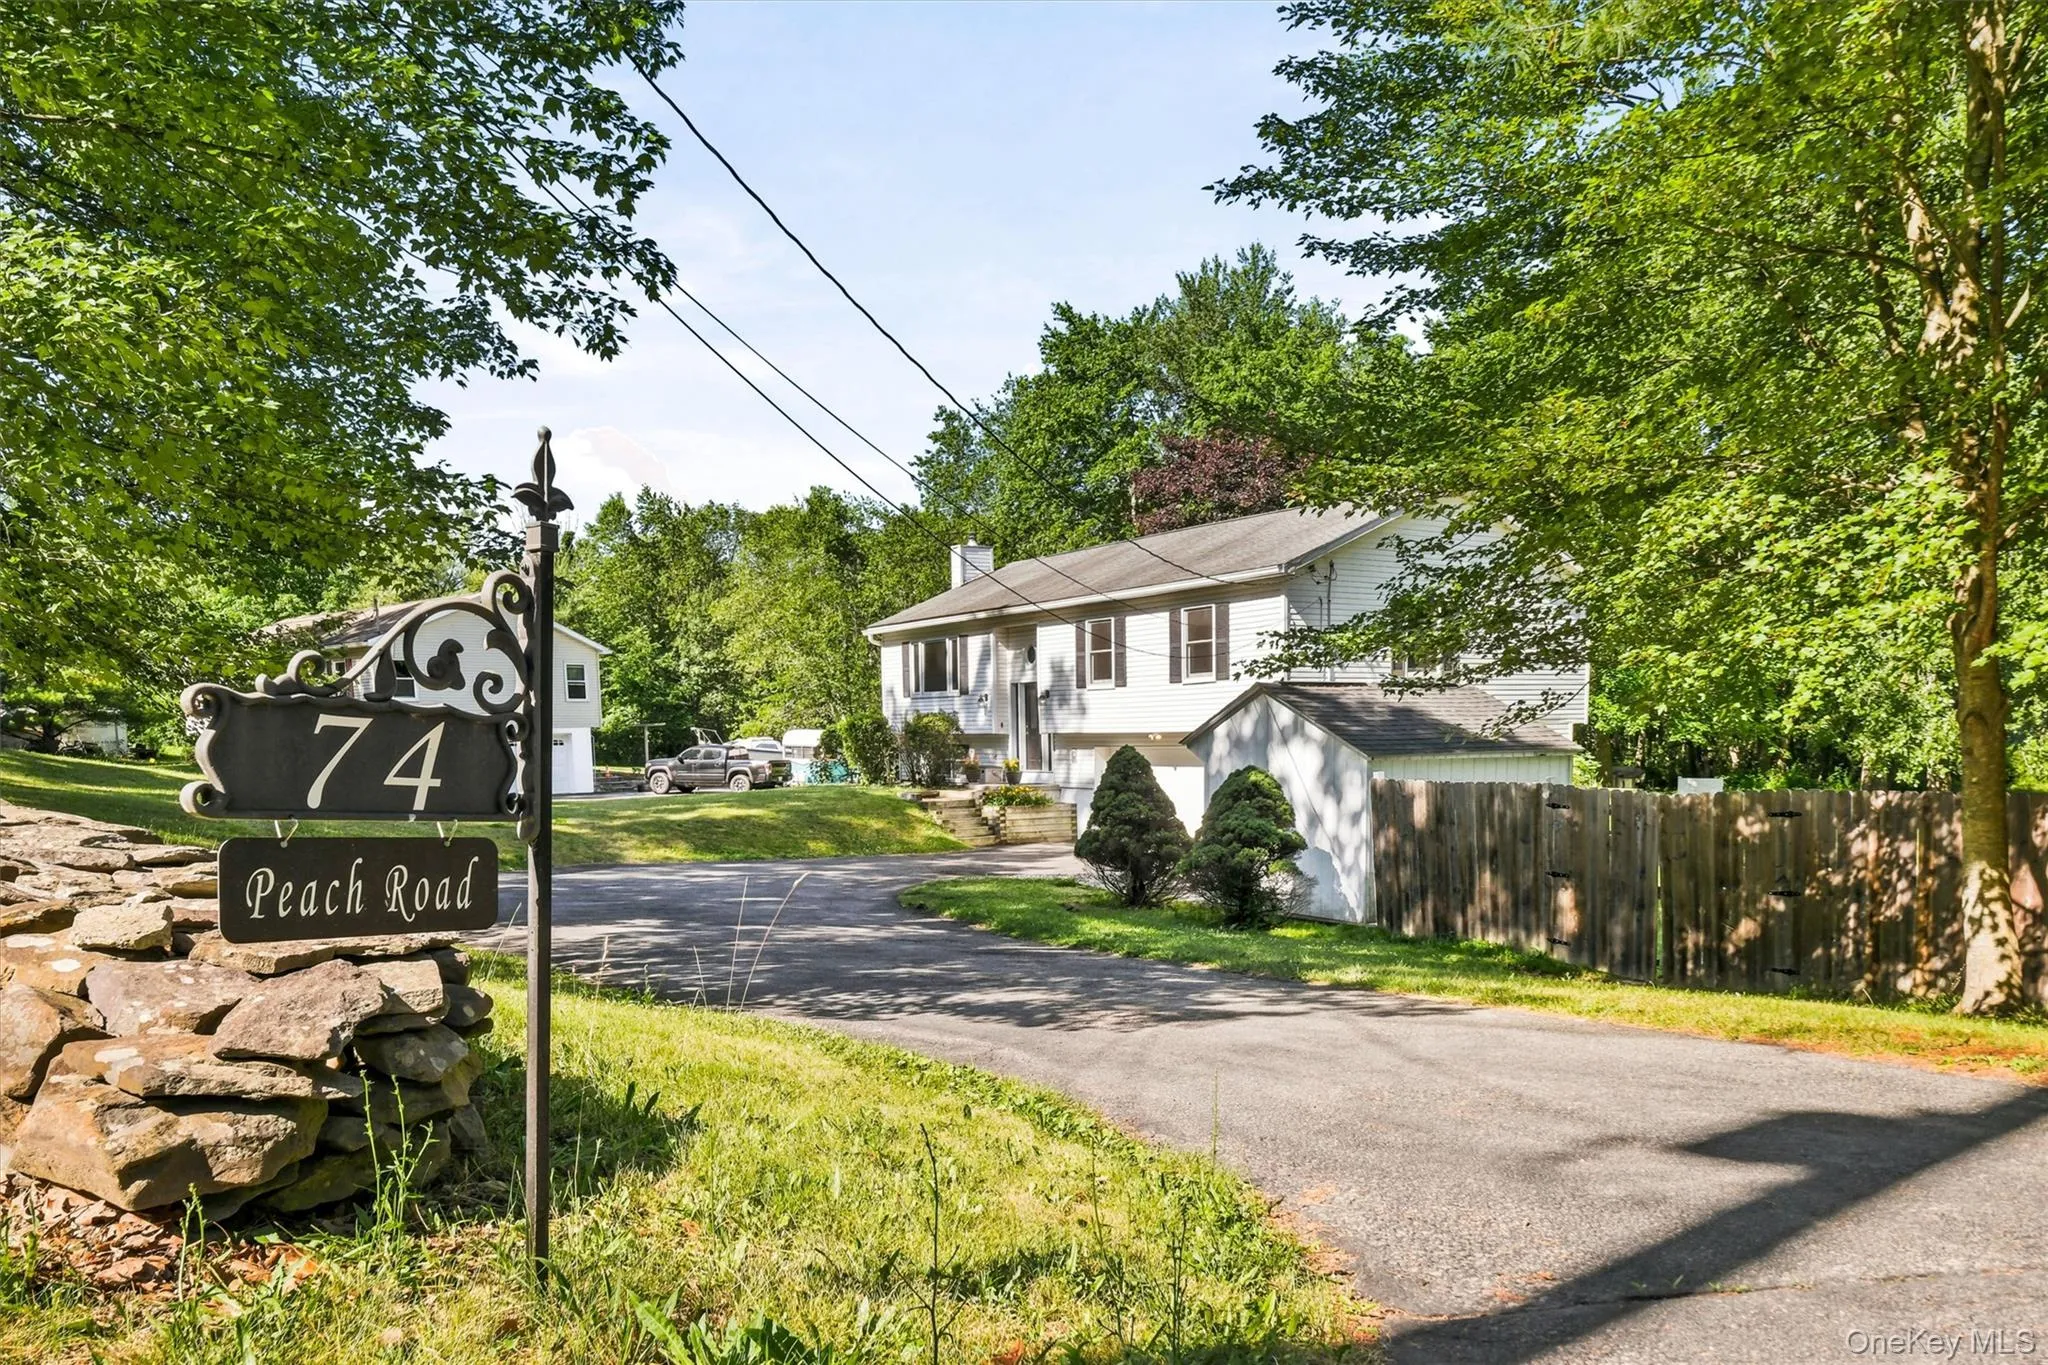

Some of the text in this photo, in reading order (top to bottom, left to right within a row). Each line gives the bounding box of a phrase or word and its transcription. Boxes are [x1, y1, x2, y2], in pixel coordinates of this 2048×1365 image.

[306, 713, 445, 811] 74
[245, 855, 479, 922] Peach Road
